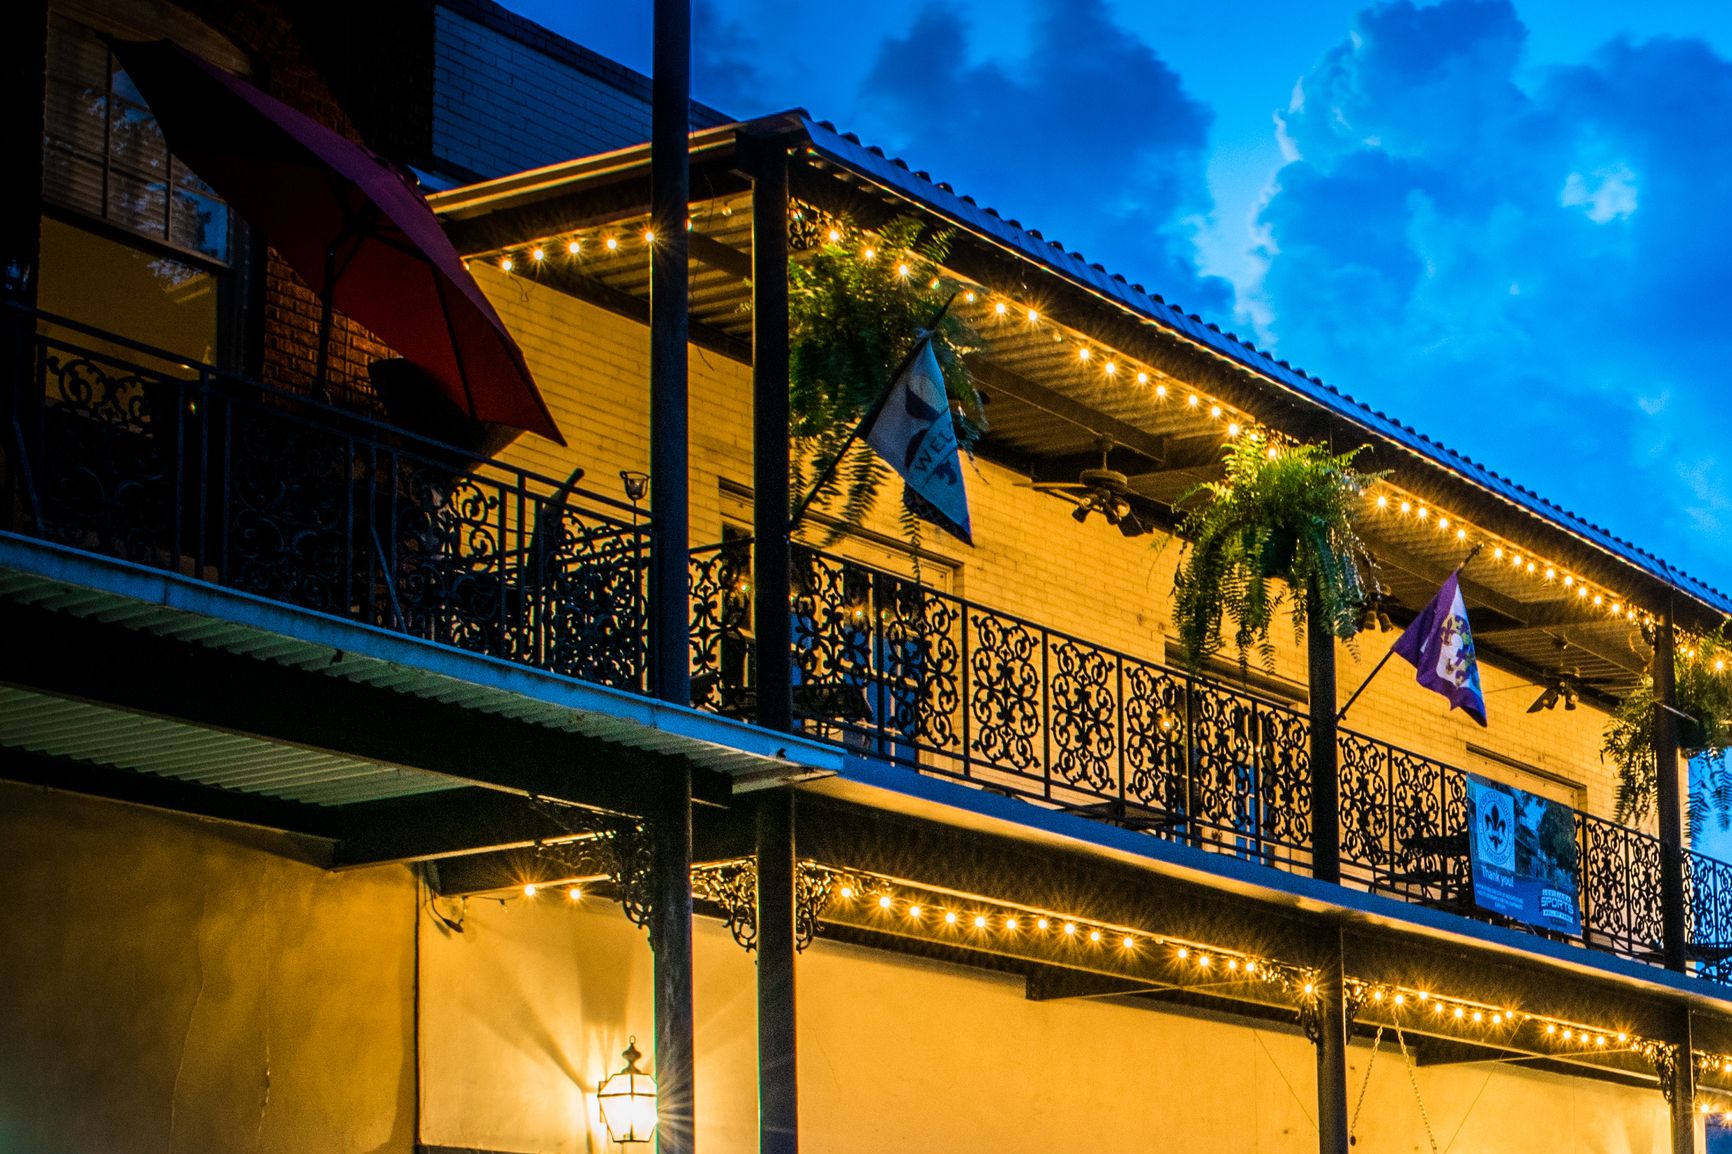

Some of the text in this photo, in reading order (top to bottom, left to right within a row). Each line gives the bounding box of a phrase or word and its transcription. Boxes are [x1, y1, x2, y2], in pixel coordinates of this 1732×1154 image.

[914, 422, 954, 472] WEL
[1482, 865, 1514, 888] Thank you!
[1541, 896, 1574, 915] SPORTS
